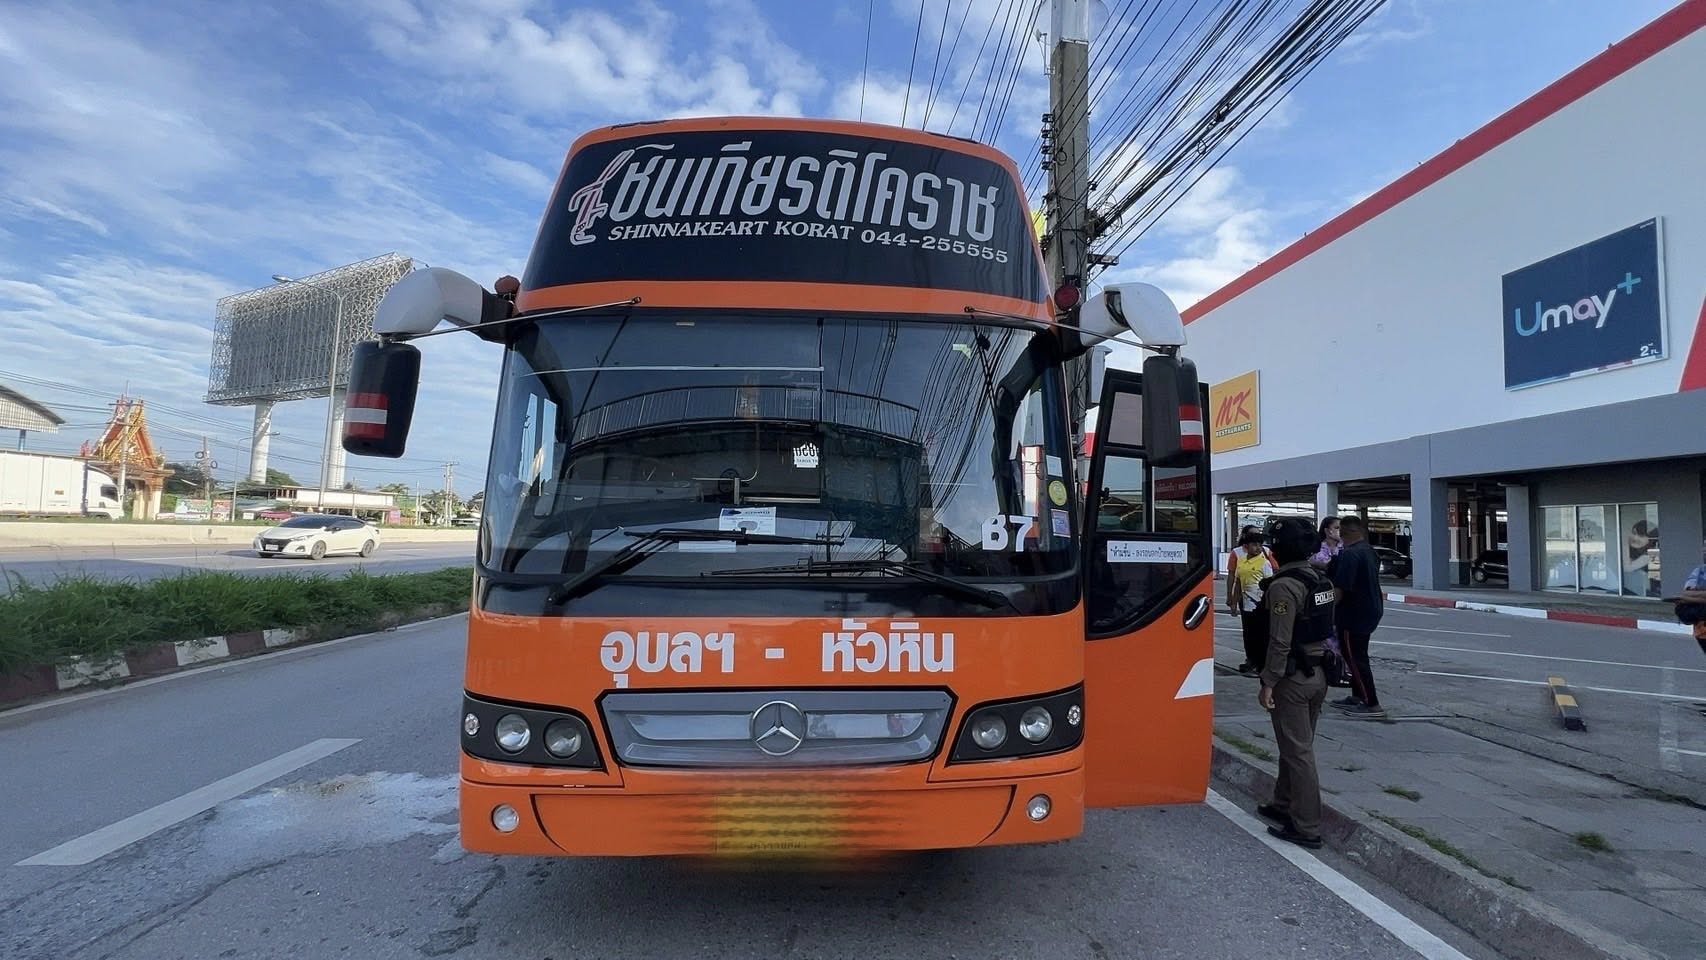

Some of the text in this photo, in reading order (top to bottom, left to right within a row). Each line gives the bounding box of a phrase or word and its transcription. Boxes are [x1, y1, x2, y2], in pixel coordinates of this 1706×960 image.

[608, 220, 1009, 264] SHINNAKEART KORAT 044-255555
[1216, 388, 1252, 428] MK
[981, 514, 1034, 552] B7
[1315, 591, 1335, 604] POLICE
[600, 631, 735, 688] อุบลฯ
[821, 618, 955, 673] หัวหิน
